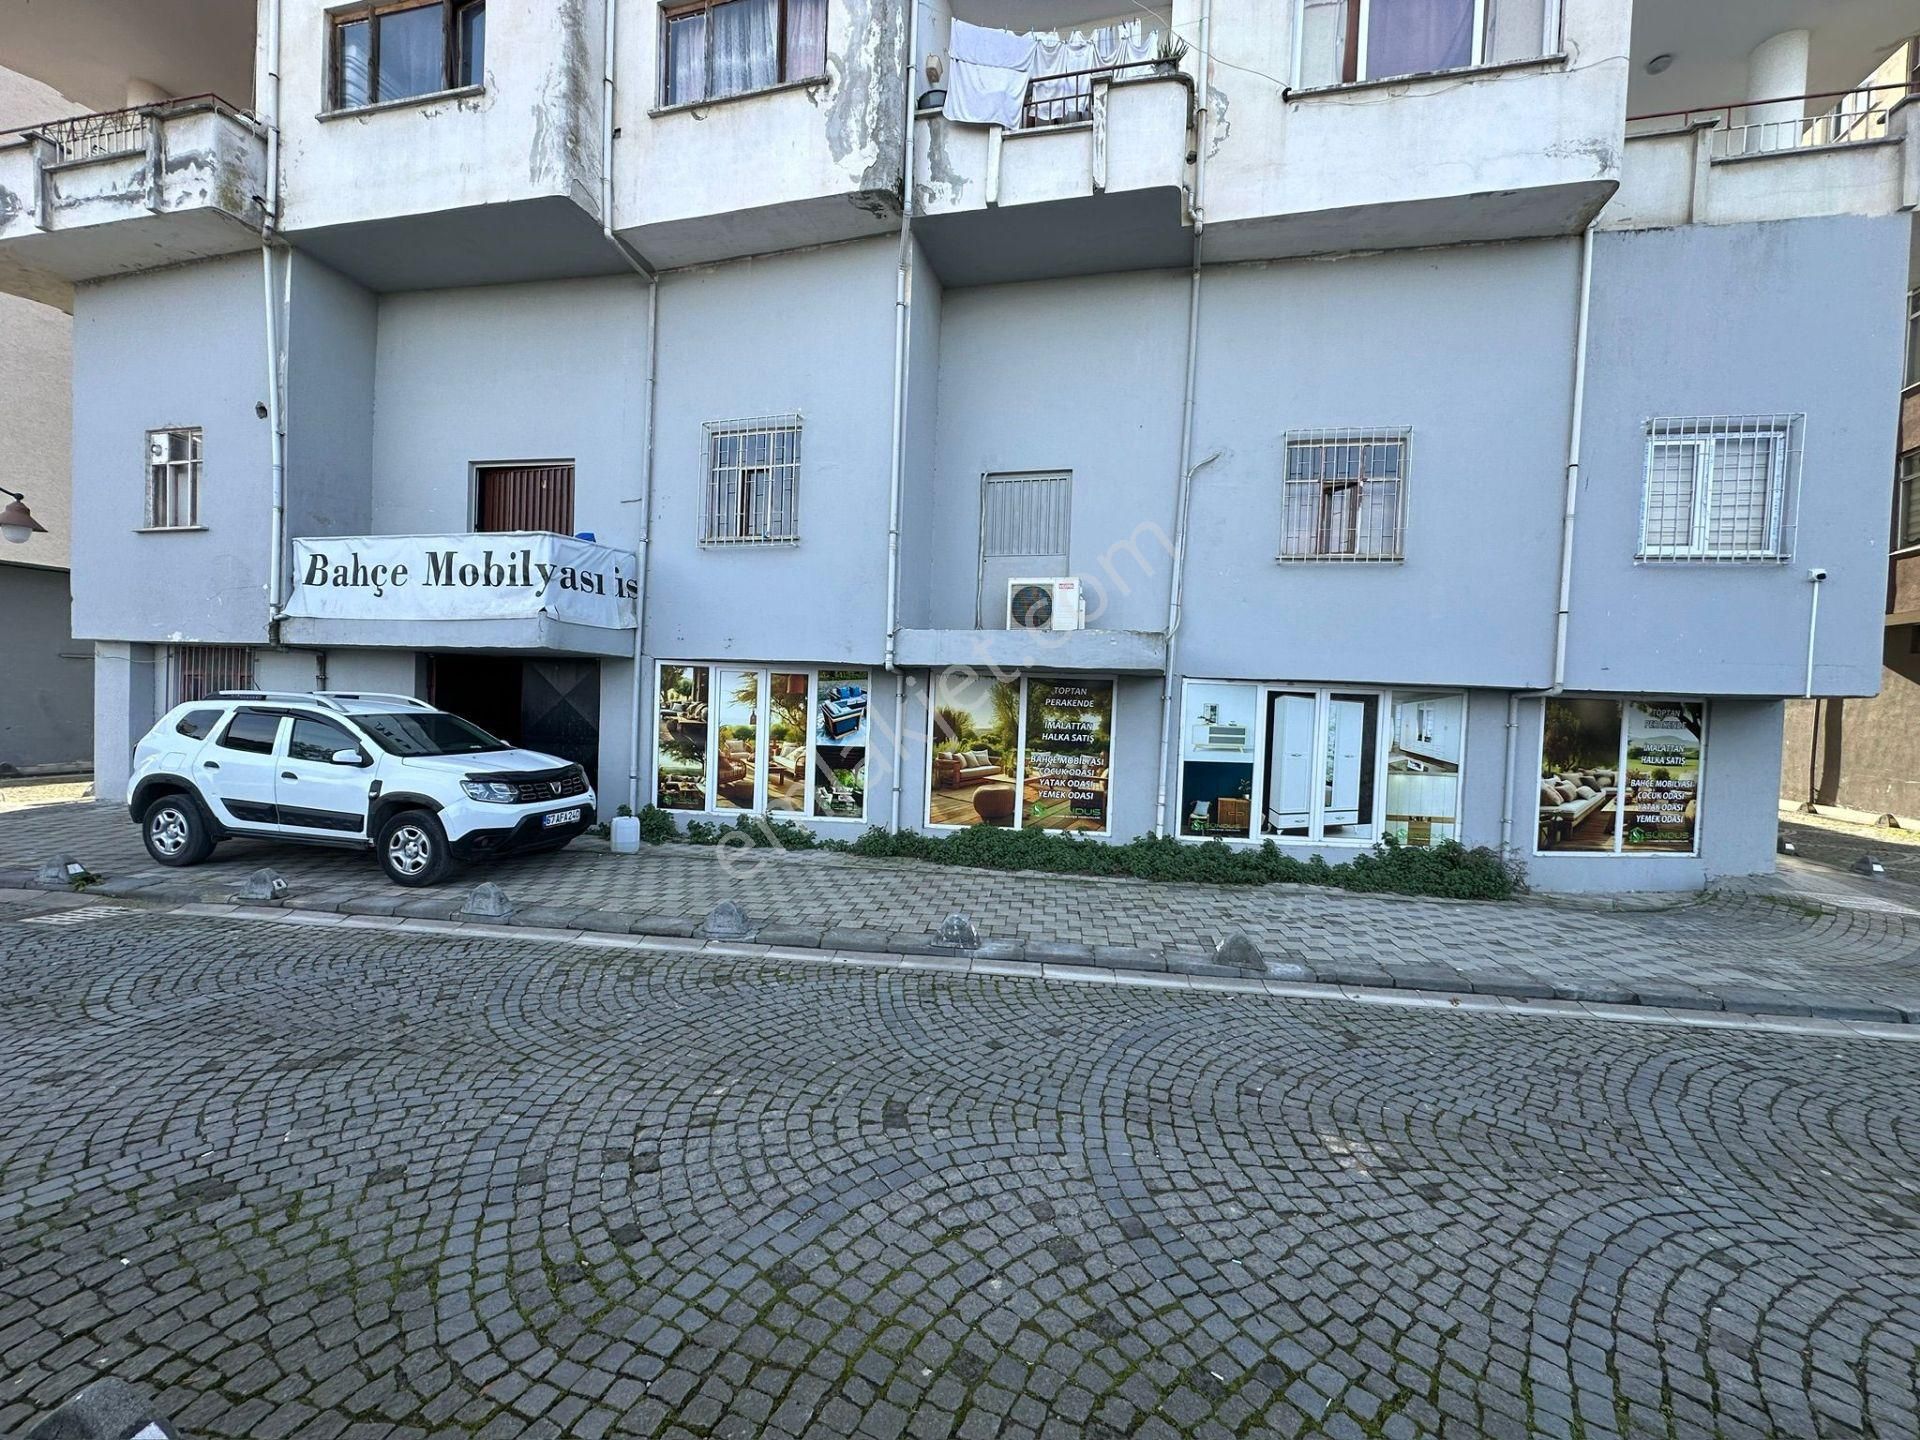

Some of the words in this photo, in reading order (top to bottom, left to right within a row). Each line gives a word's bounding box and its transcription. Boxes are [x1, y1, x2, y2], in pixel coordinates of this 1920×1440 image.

[302, 552, 408, 597] Bahçe
[422, 550, 606, 597] Mobilyası
[1053, 686, 1088, 696] TOPTAN
[1045, 698, 1095, 708] PERAKENDE
[1044, 719, 1094, 731] İMALATTAN
[1041, 732, 1070, 742] HALKA
[1071, 733, 1095, 744] SATIŞ
[1030, 755, 1057, 765] BAHÇE
[1641, 755, 1665, 764] HALKA
[1666, 756, 1686, 766] SATIŞ
[1068, 768, 1094, 777] ODASI
[1039, 778, 1066, 787] YATAK
[1067, 779, 1094, 788] ODASI
[1630, 779, 1654, 788] BAHÇE
[1038, 790, 1066, 799] YEMEK
[1067, 791, 1094, 800] ODASI
[1662, 792, 1685, 800] ODASI
[1661, 803, 1684, 811] ODASI
[1636, 814, 1660, 823] YEMEK
[1661, 815, 1684, 823] ODASI
